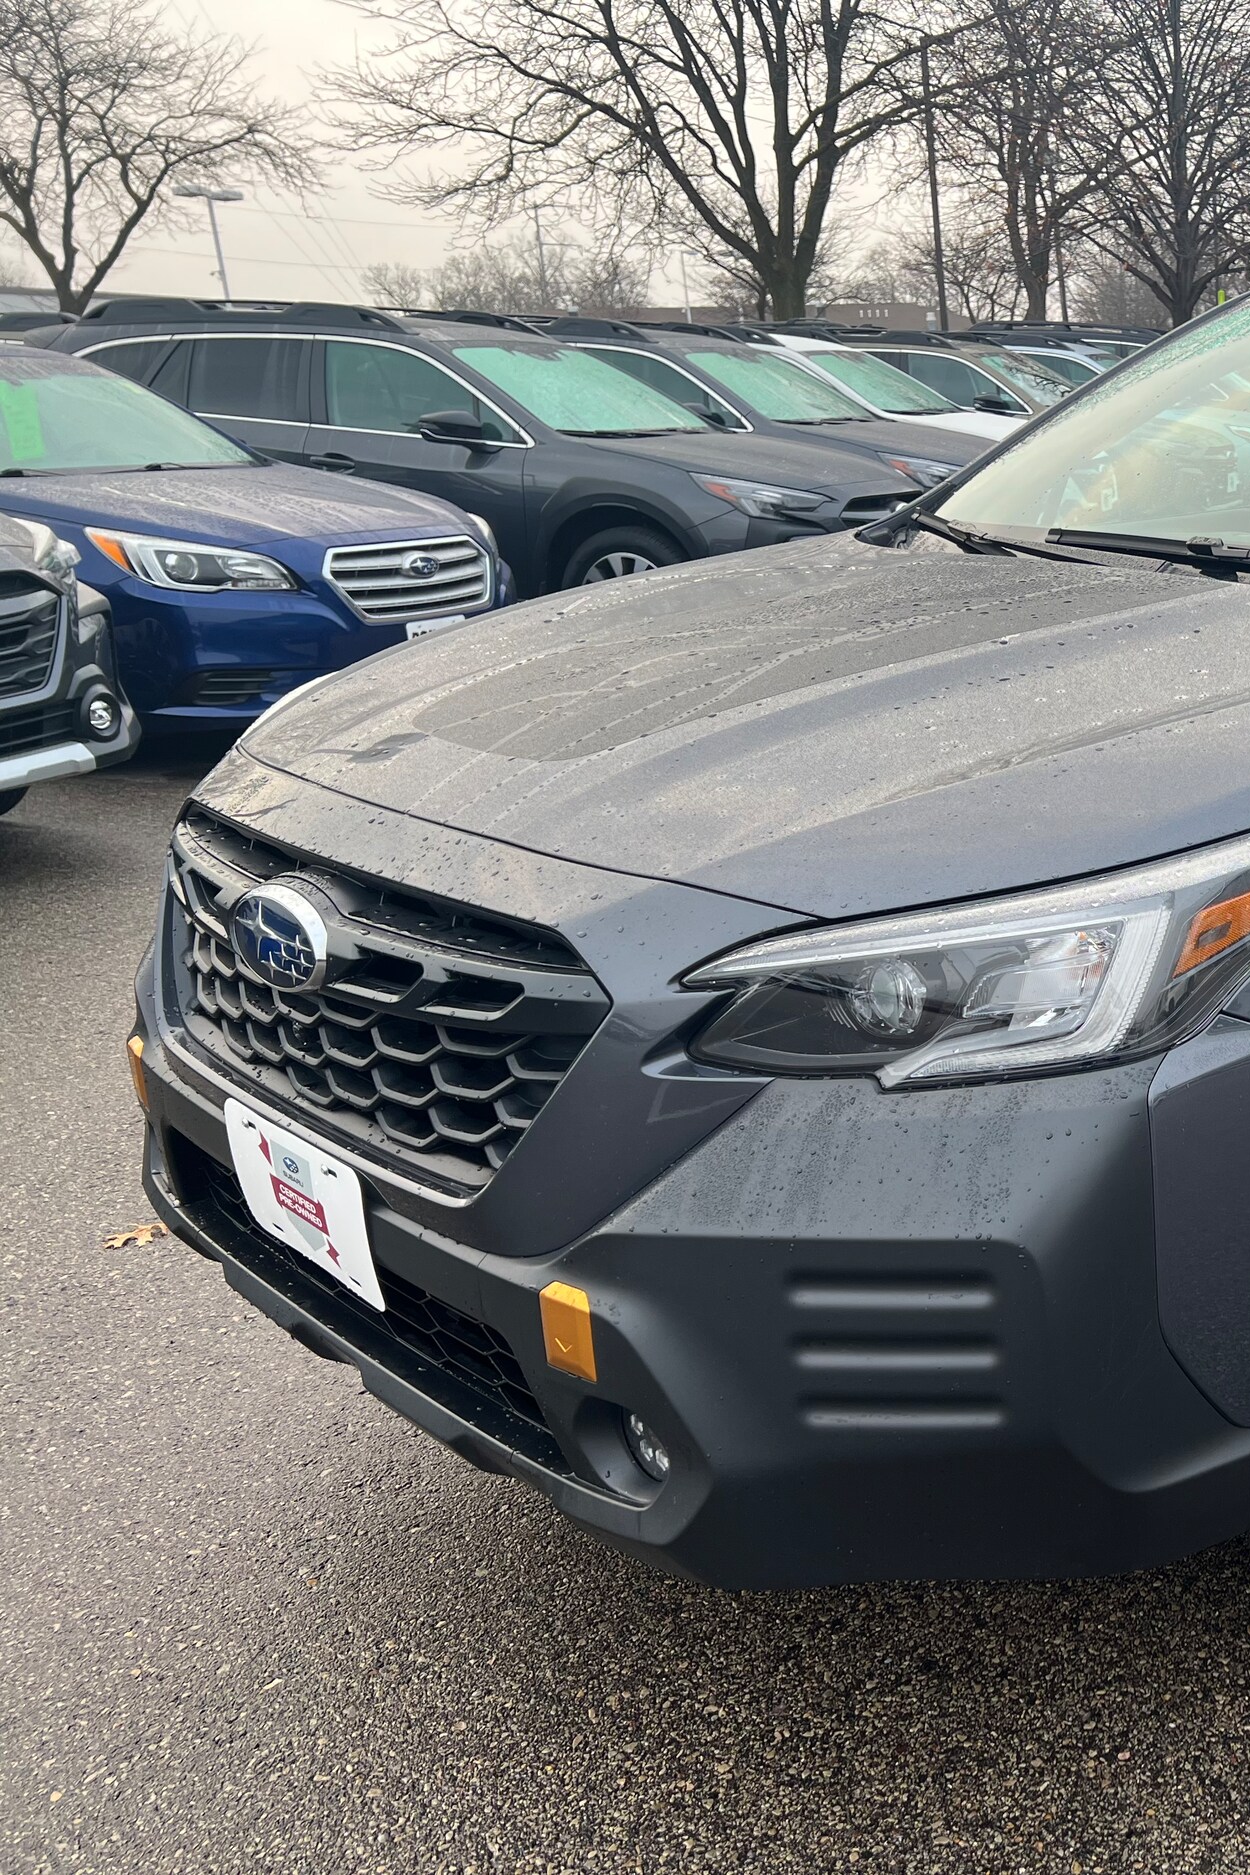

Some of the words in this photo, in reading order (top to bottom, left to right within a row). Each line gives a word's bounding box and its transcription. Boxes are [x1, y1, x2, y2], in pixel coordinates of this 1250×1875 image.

[283, 1170, 304, 1187] SUBARU
[278, 1193, 323, 1227] PRE-OWNED
[279, 1184, 316, 1213] CERTIFIED
